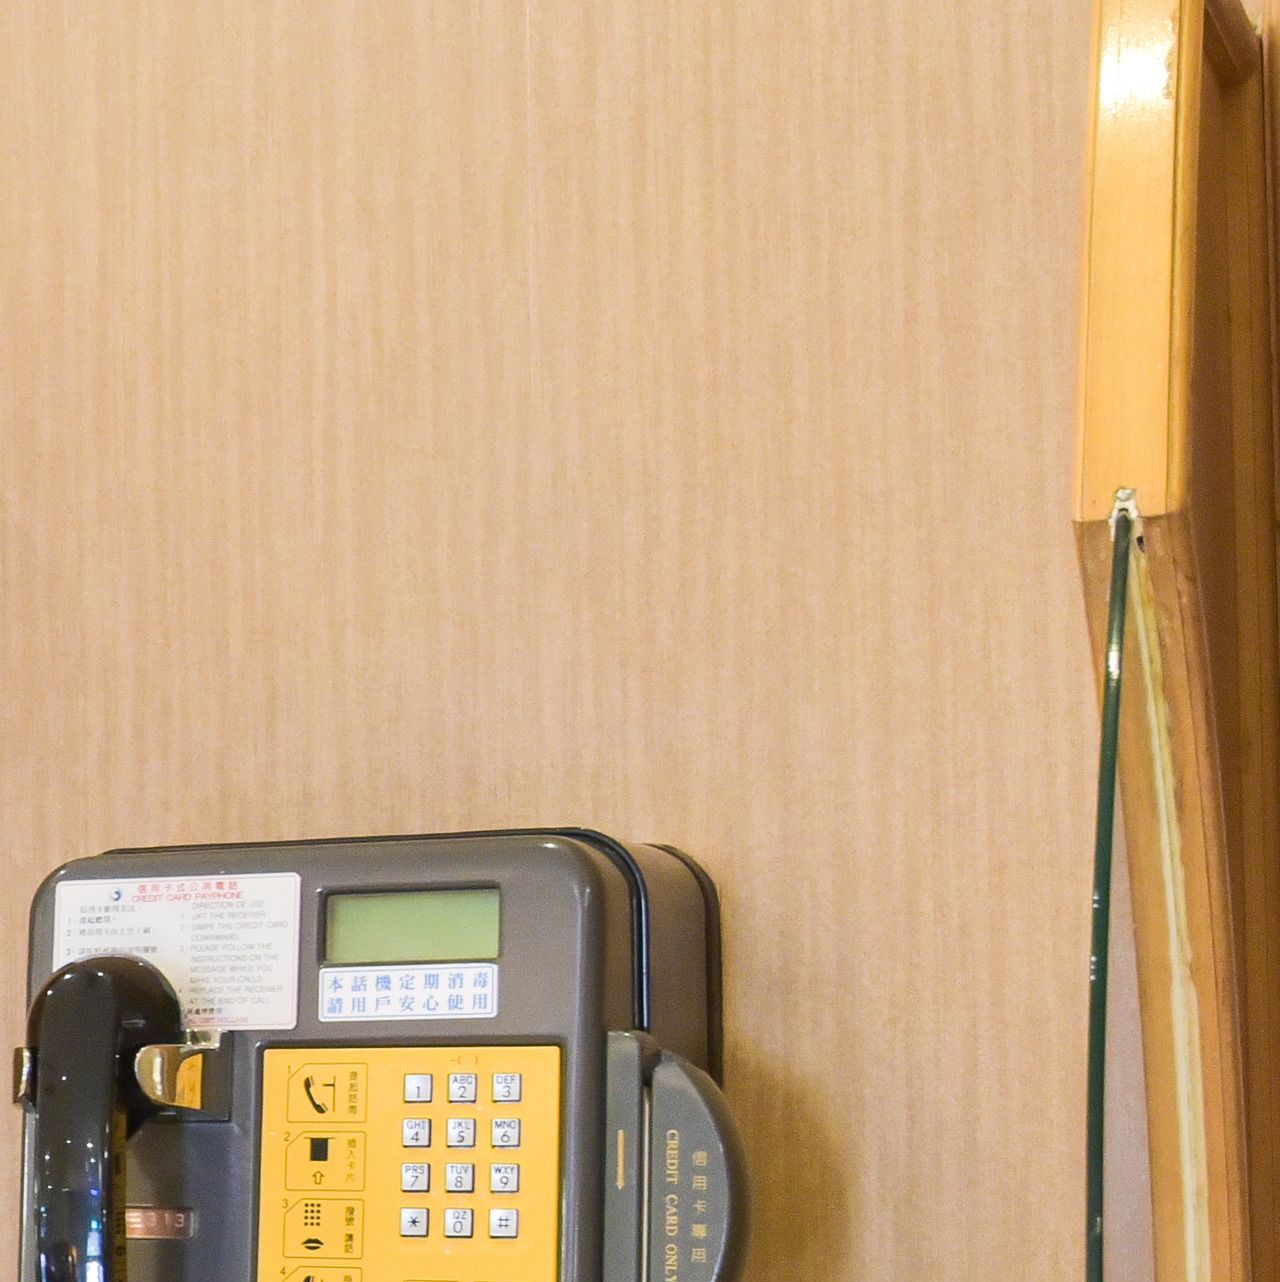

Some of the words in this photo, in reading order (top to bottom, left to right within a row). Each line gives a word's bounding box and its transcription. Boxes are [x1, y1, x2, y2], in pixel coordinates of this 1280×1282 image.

[132, 894, 162, 902] CREDIT
[167, 893, 191, 901] CARD
[194, 892, 244, 900] PAYPHONE
[327, 972, 489, 993] 本話機定期消毒
[326, 993, 488, 1014] 請用戶安心使用
[452, 1075, 473, 1085] ABC
[496, 1075, 516, 1084] DEF
[415, 1086, 421, 1098] 1
[457, 1086, 467, 1098] 2
[501, 1086, 511, 1098] 3
[406, 1120, 426, 1130] GHI
[452, 1121, 471, 1129] JKL
[494, 1121, 516, 1129] MNO
[284, 1131, 290, 1141] 2
[410, 1131, 419, 1142] 4
[456, 1131, 465, 1143] 5
[500, 1131, 510, 1143] 6
[666, 1129, 679, 1185] CREDIT
[404, 1165, 425, 1174] PRS
[450, 1165, 470, 1174] TUV
[493, 1165, 515, 1174] WXY
[410, 1175, 419, 1187] 7
[454, 1175, 463, 1188] 8
[499, 1176, 509, 1189] 9
[282, 1198, 288, 1208] 3
[453, 1211, 467, 1220] QZ
[665, 1193, 679, 1237] CARD
[453, 1221, 463, 1233] 0
[280, 1266, 287, 1276] 4
